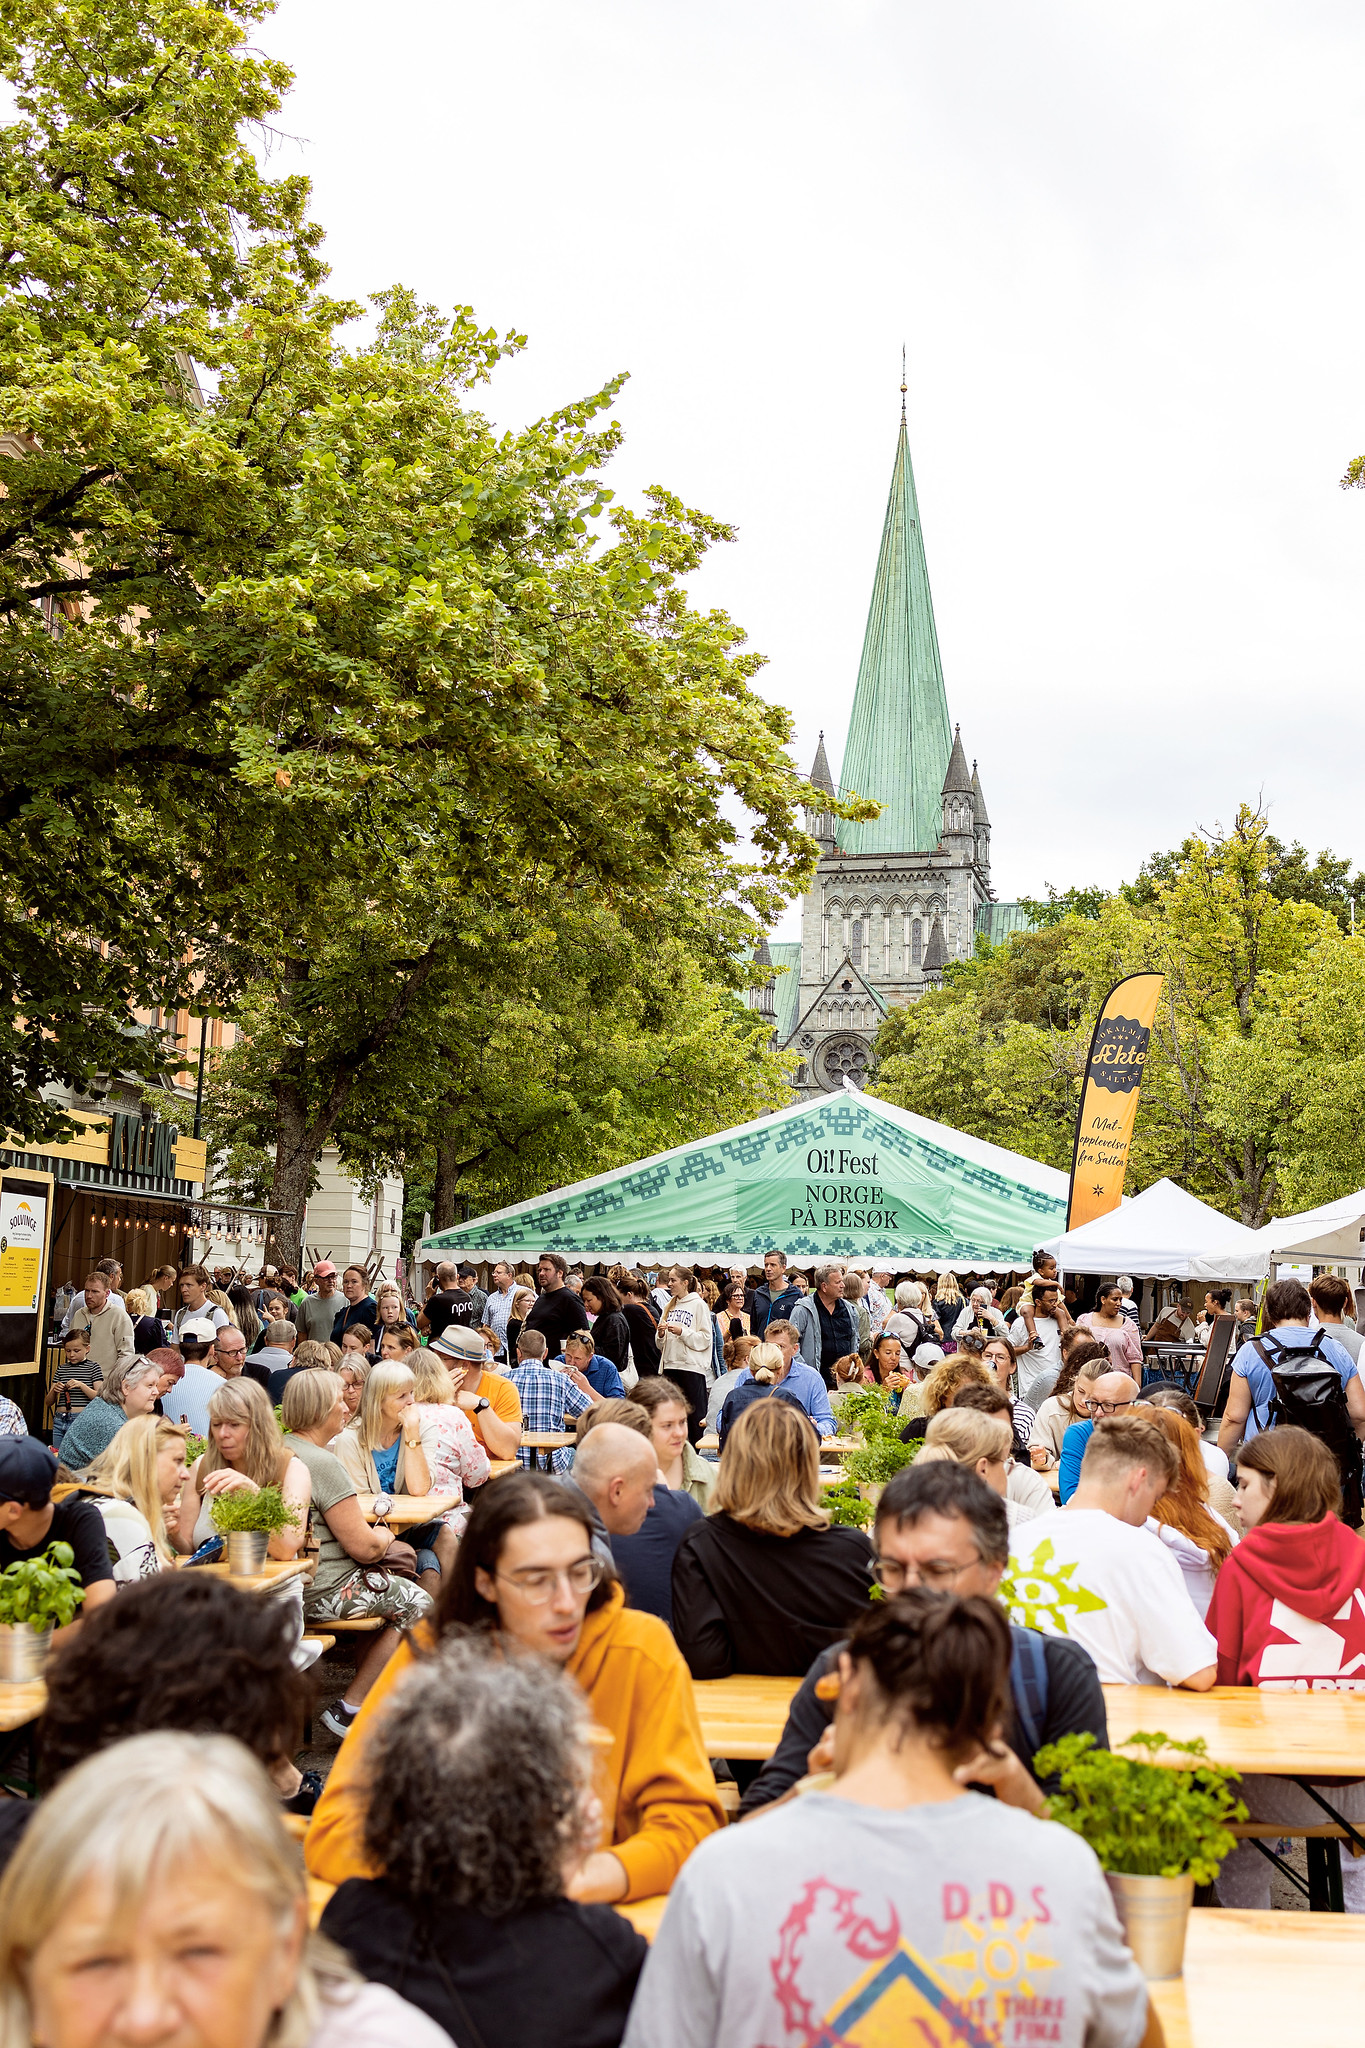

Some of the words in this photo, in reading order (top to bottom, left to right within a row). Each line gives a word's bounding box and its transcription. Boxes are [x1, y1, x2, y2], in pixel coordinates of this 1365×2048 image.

[1095, 1026, 1146, 1044] LOKALMAT
[1091, 1043, 1146, 1065] Ækte
[1092, 1116, 1122, 1131] Mat-
[112, 1112, 178, 1179] KYLLING
[838, 1150, 879, 1175] Fest
[1077, 1150, 1094, 1166] fra
[1095, 1151, 1125, 1166] Salten
[806, 1185, 883, 1204] NORGE
[9, 1214, 37, 1232] SOLVINGE
[790, 1203, 818, 1226] PÅ
[824, 1209, 899, 1228] BESØK
